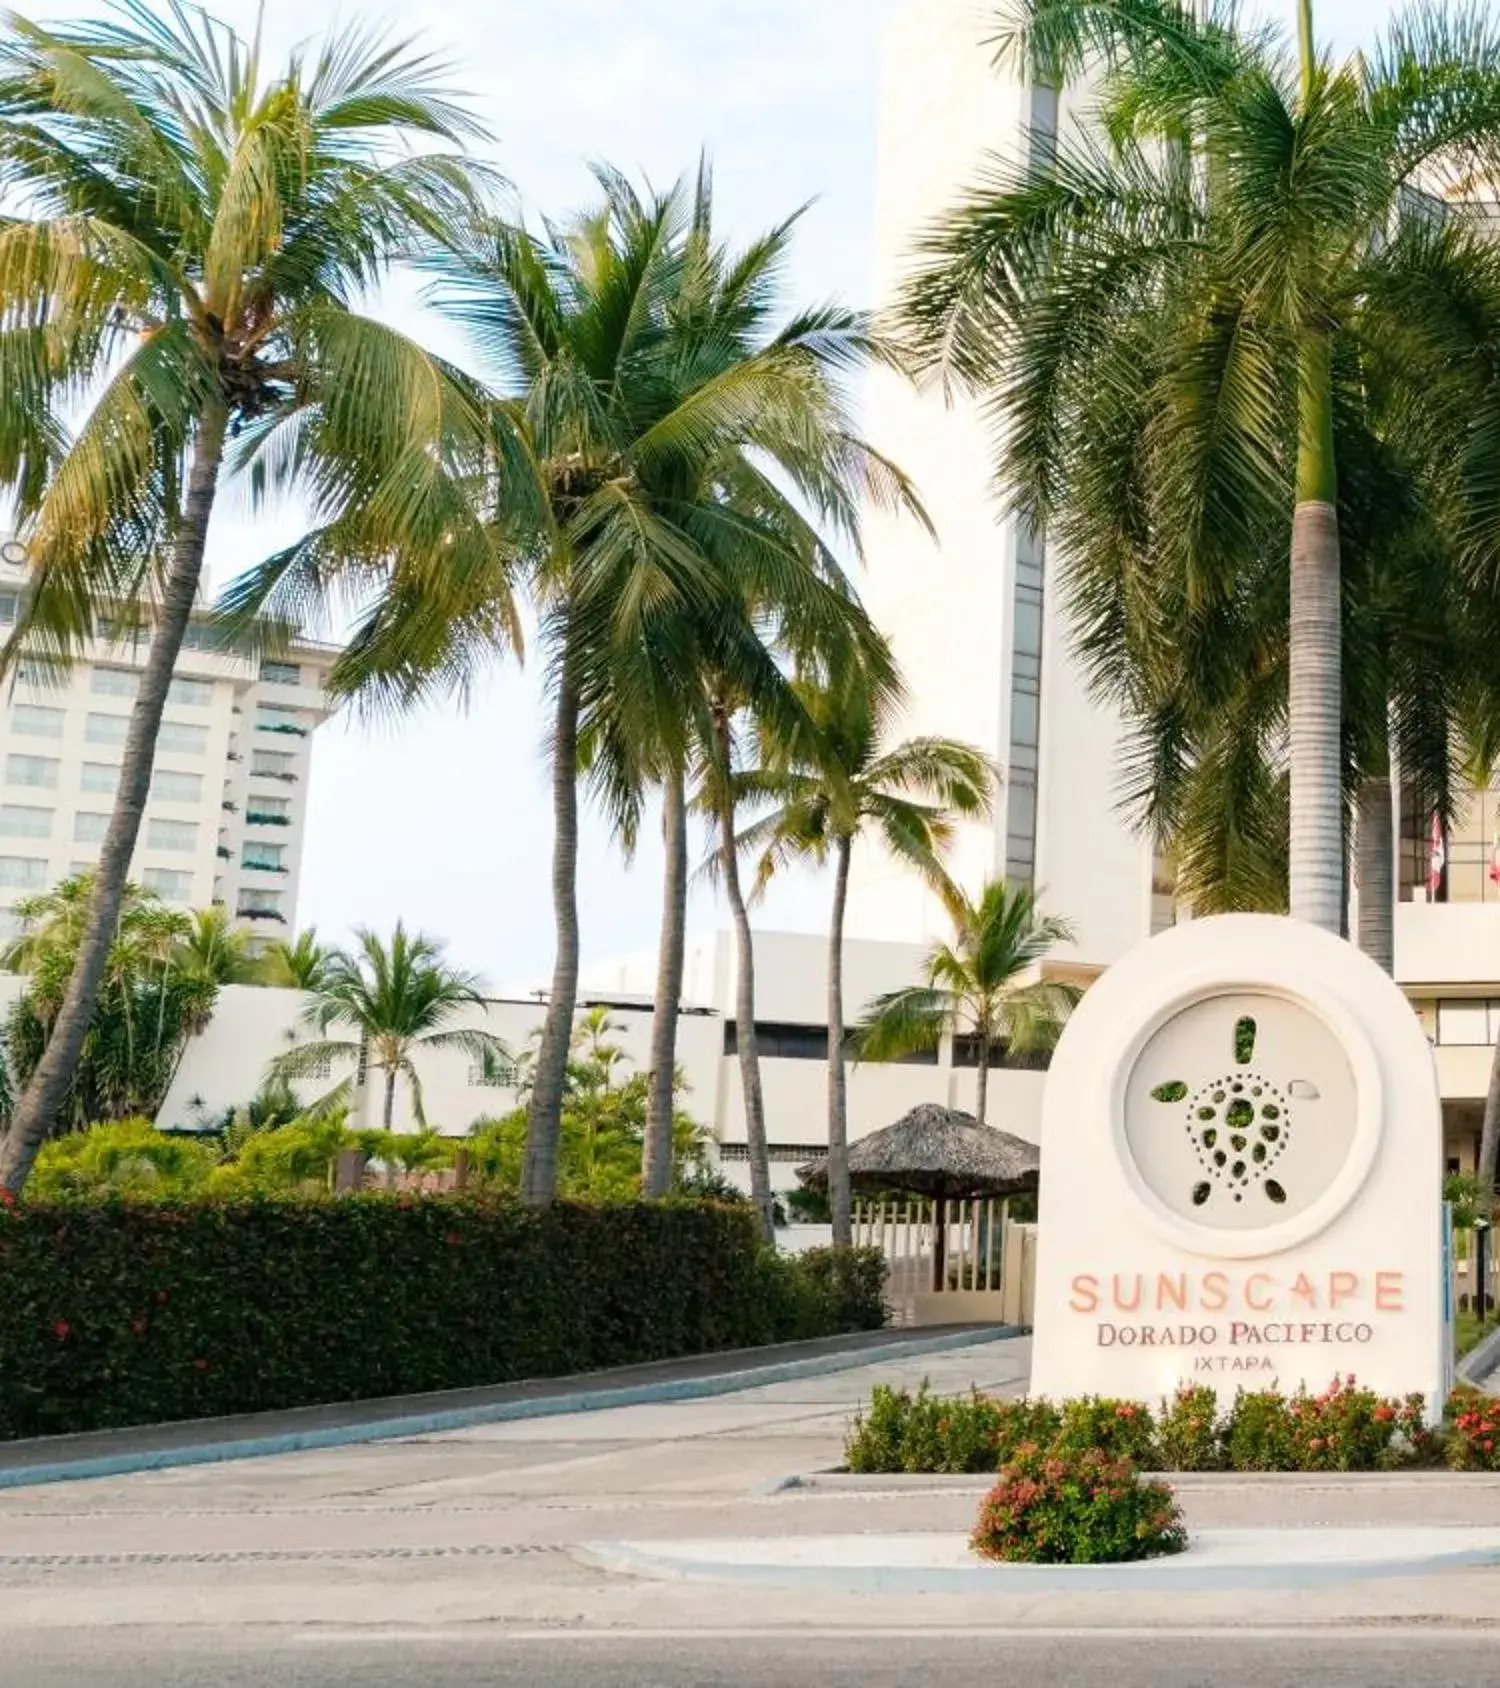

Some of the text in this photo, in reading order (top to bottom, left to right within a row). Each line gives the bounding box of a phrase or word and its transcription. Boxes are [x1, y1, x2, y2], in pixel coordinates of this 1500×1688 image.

[1069, 1271, 1405, 1313] SUNSCAPE
[1098, 1323, 1217, 1347] DORADO
[1194, 1355, 1273, 1371] IXTAPA
